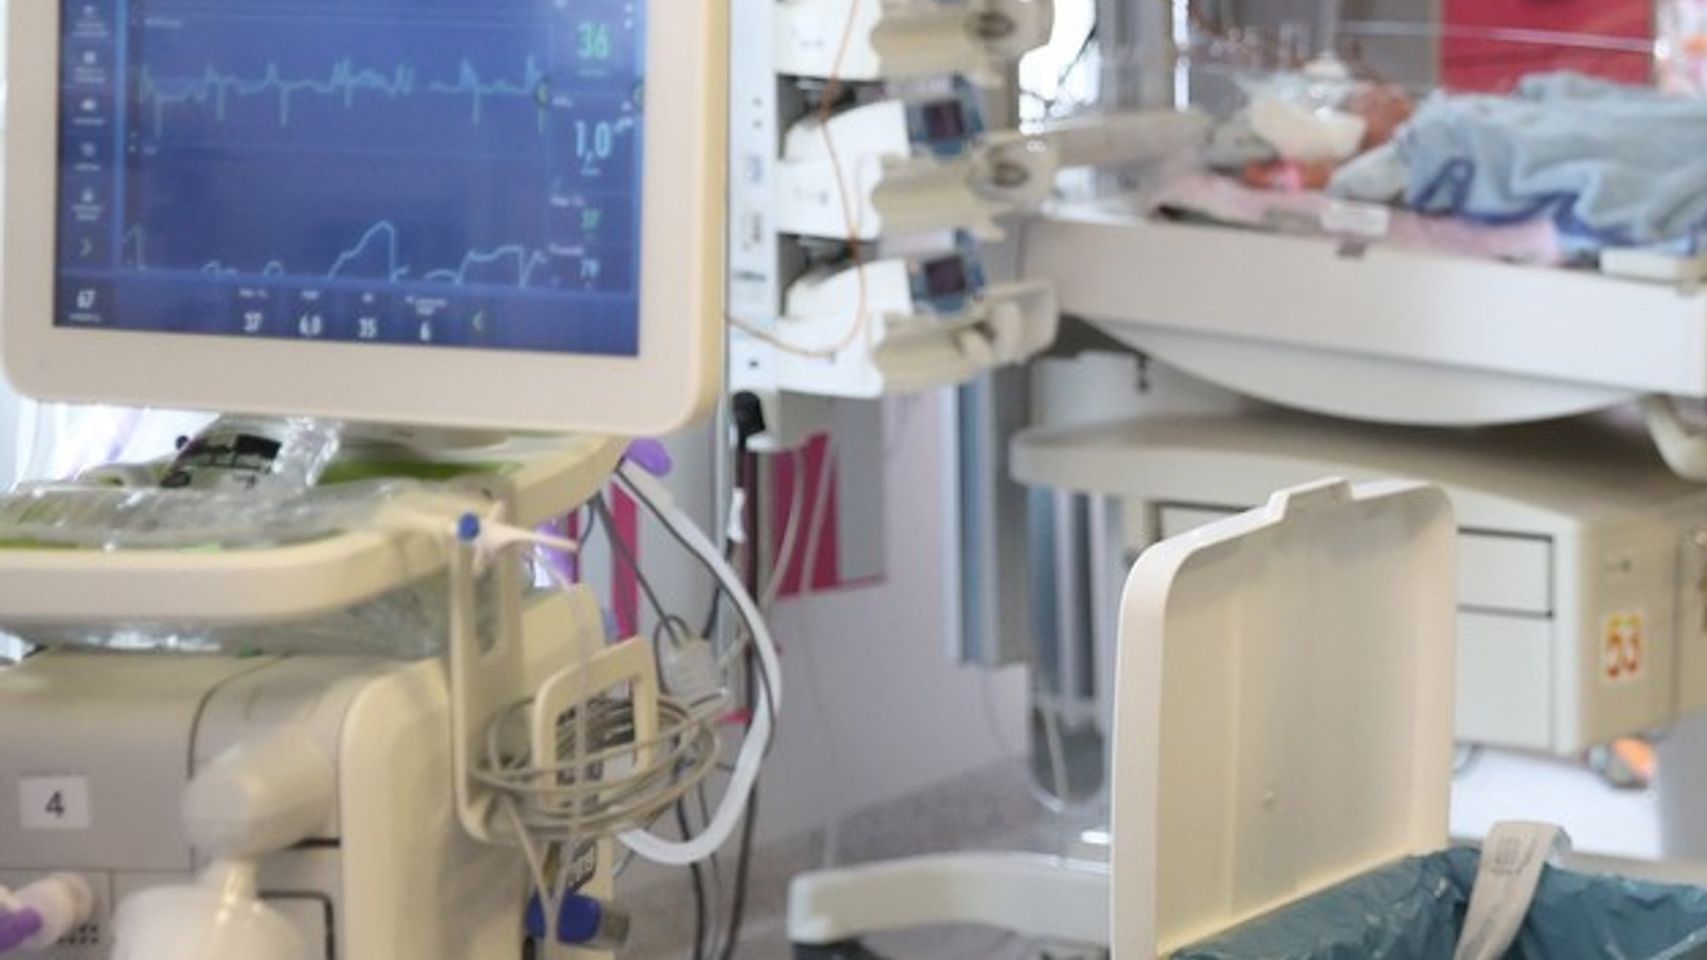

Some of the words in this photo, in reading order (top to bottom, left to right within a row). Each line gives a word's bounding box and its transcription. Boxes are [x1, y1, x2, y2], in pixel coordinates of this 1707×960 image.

[576, 22, 610, 59] 36
[1607, 614, 1641, 678] 53
[45, 791, 64, 818] 4
